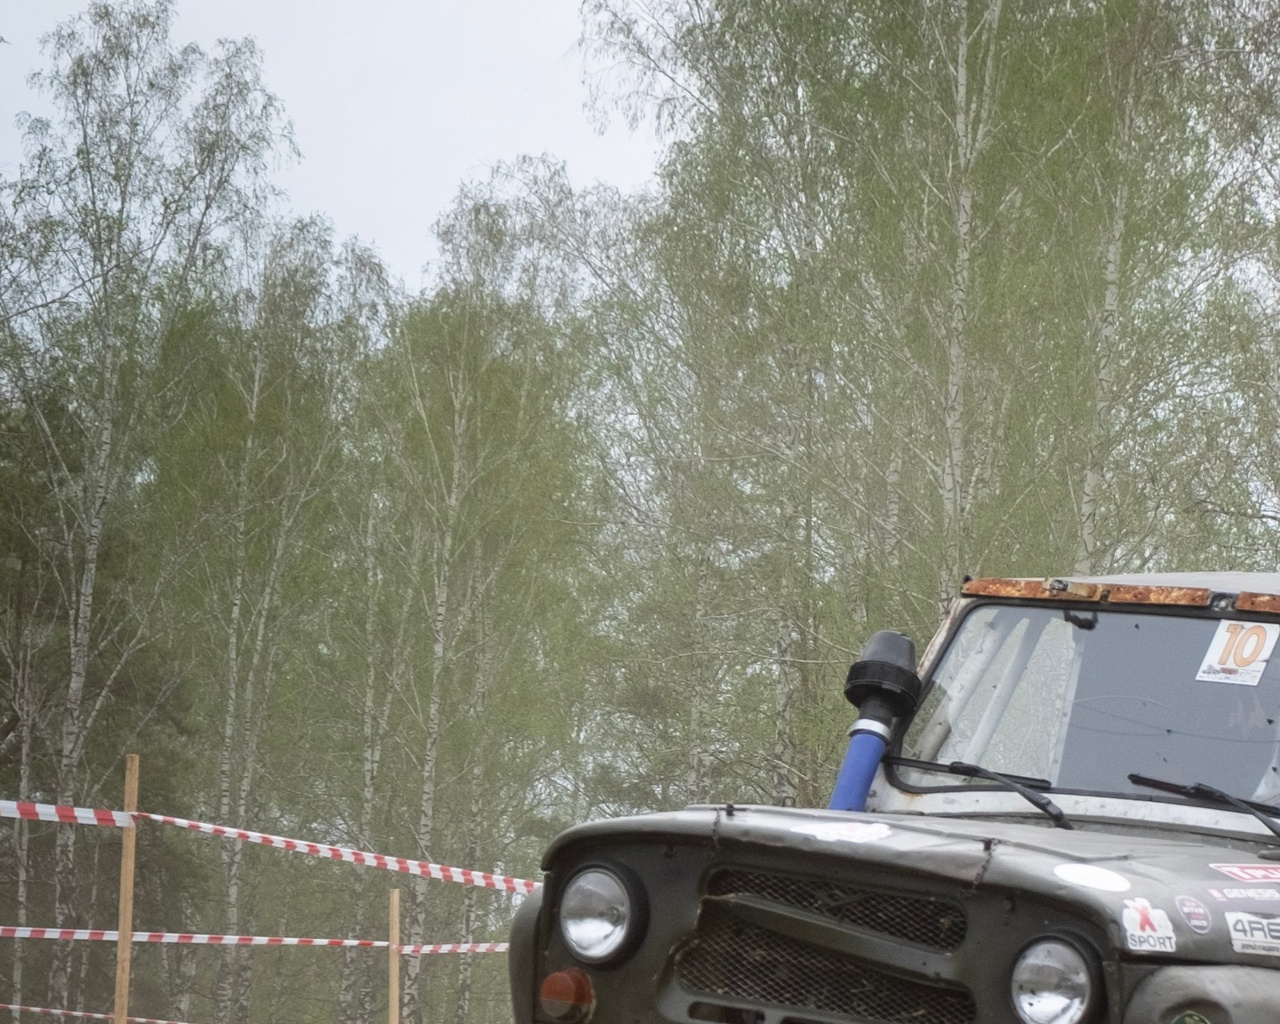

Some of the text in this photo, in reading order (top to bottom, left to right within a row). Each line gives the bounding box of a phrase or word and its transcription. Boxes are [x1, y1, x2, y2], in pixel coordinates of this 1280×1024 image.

[1218, 623, 1267, 668] 10
[1223, 888, 1280, 899] GENESIS
[1129, 934, 1175, 950] SPORT
